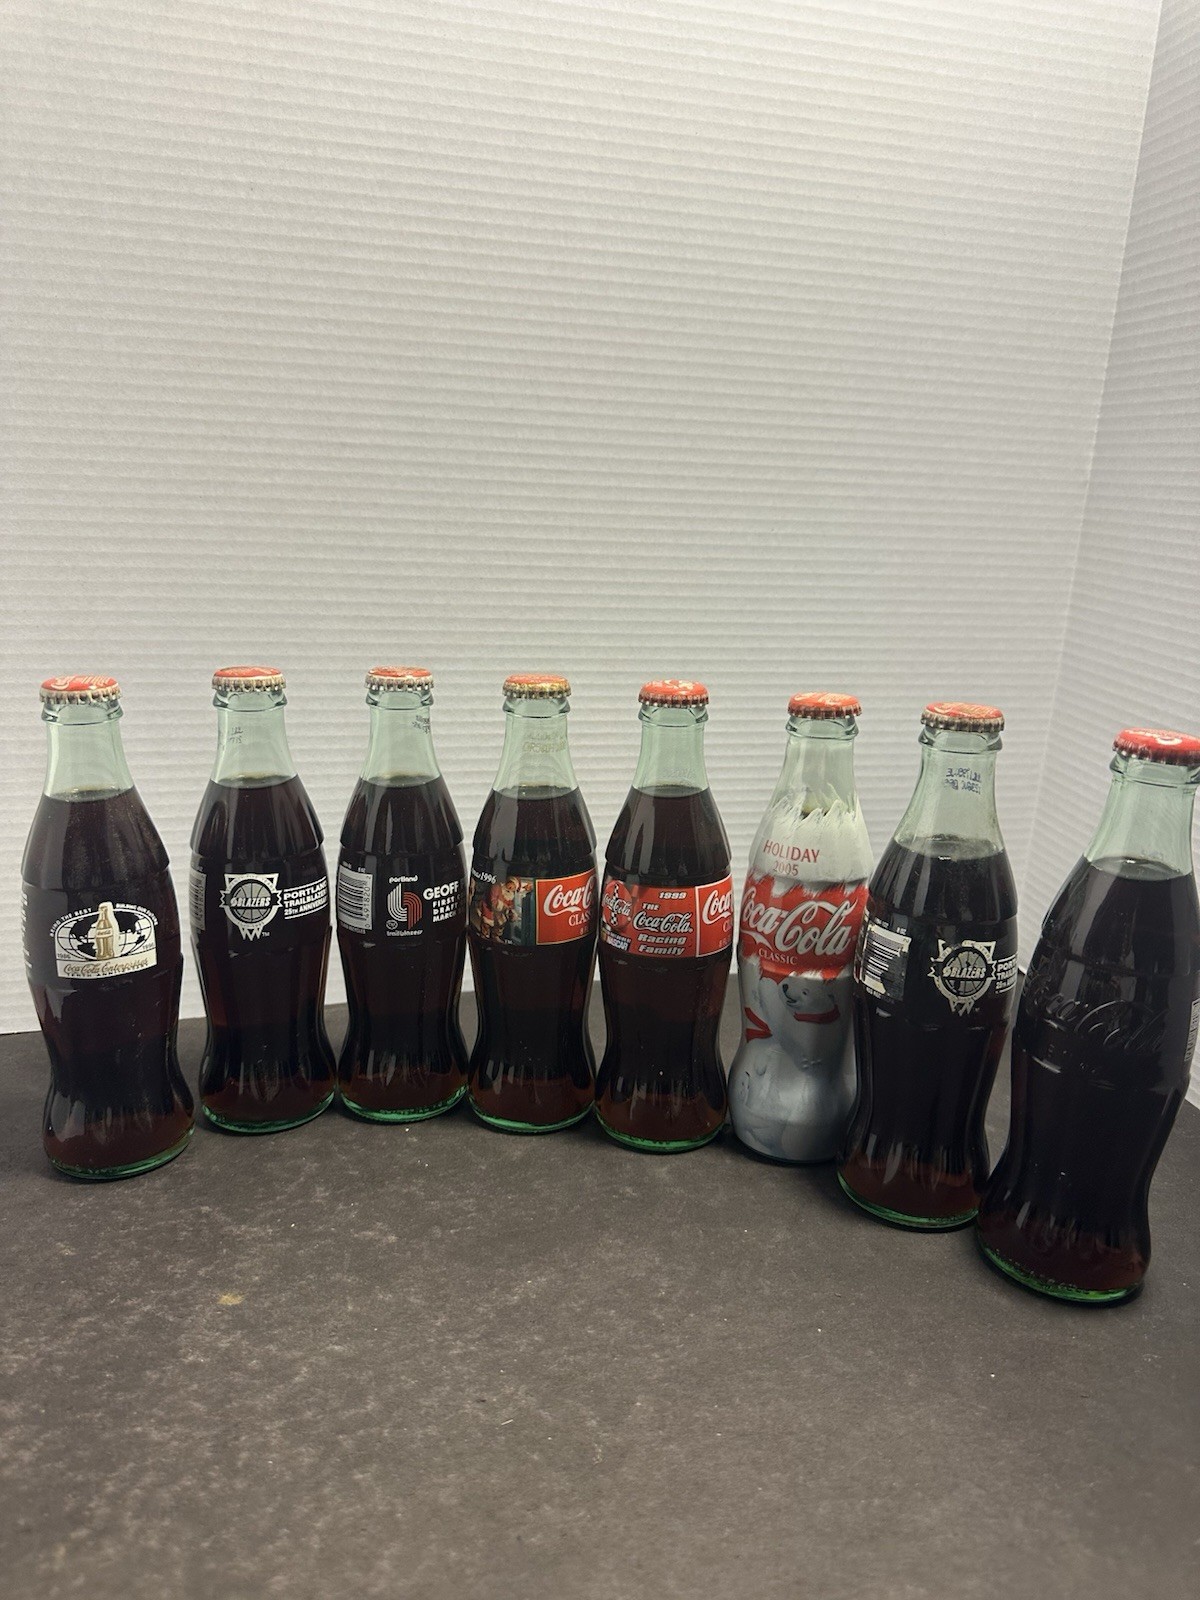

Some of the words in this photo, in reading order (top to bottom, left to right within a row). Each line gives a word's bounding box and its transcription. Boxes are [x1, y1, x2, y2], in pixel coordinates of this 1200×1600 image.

[763, 840, 820, 863] HOLIDAY
[772, 860, 799, 876] 2005
[389, 875, 418, 884] portland
[480, 872, 497, 885] 1996
[423, 880, 459, 900] GEOFF
[237, 897, 271, 907] BLAZERS
[432, 895, 455, 908] FIRST
[642, 902, 660, 911] THE
[432, 902, 458, 915] DRAFT
[633, 911, 695, 933] Coca-Cola
[740, 886, 858, 956] Coca-Cola
[637, 933, 687, 945] Racing
[638, 944, 685, 956] Family
[758, 948, 798, 965] CLASSIC
